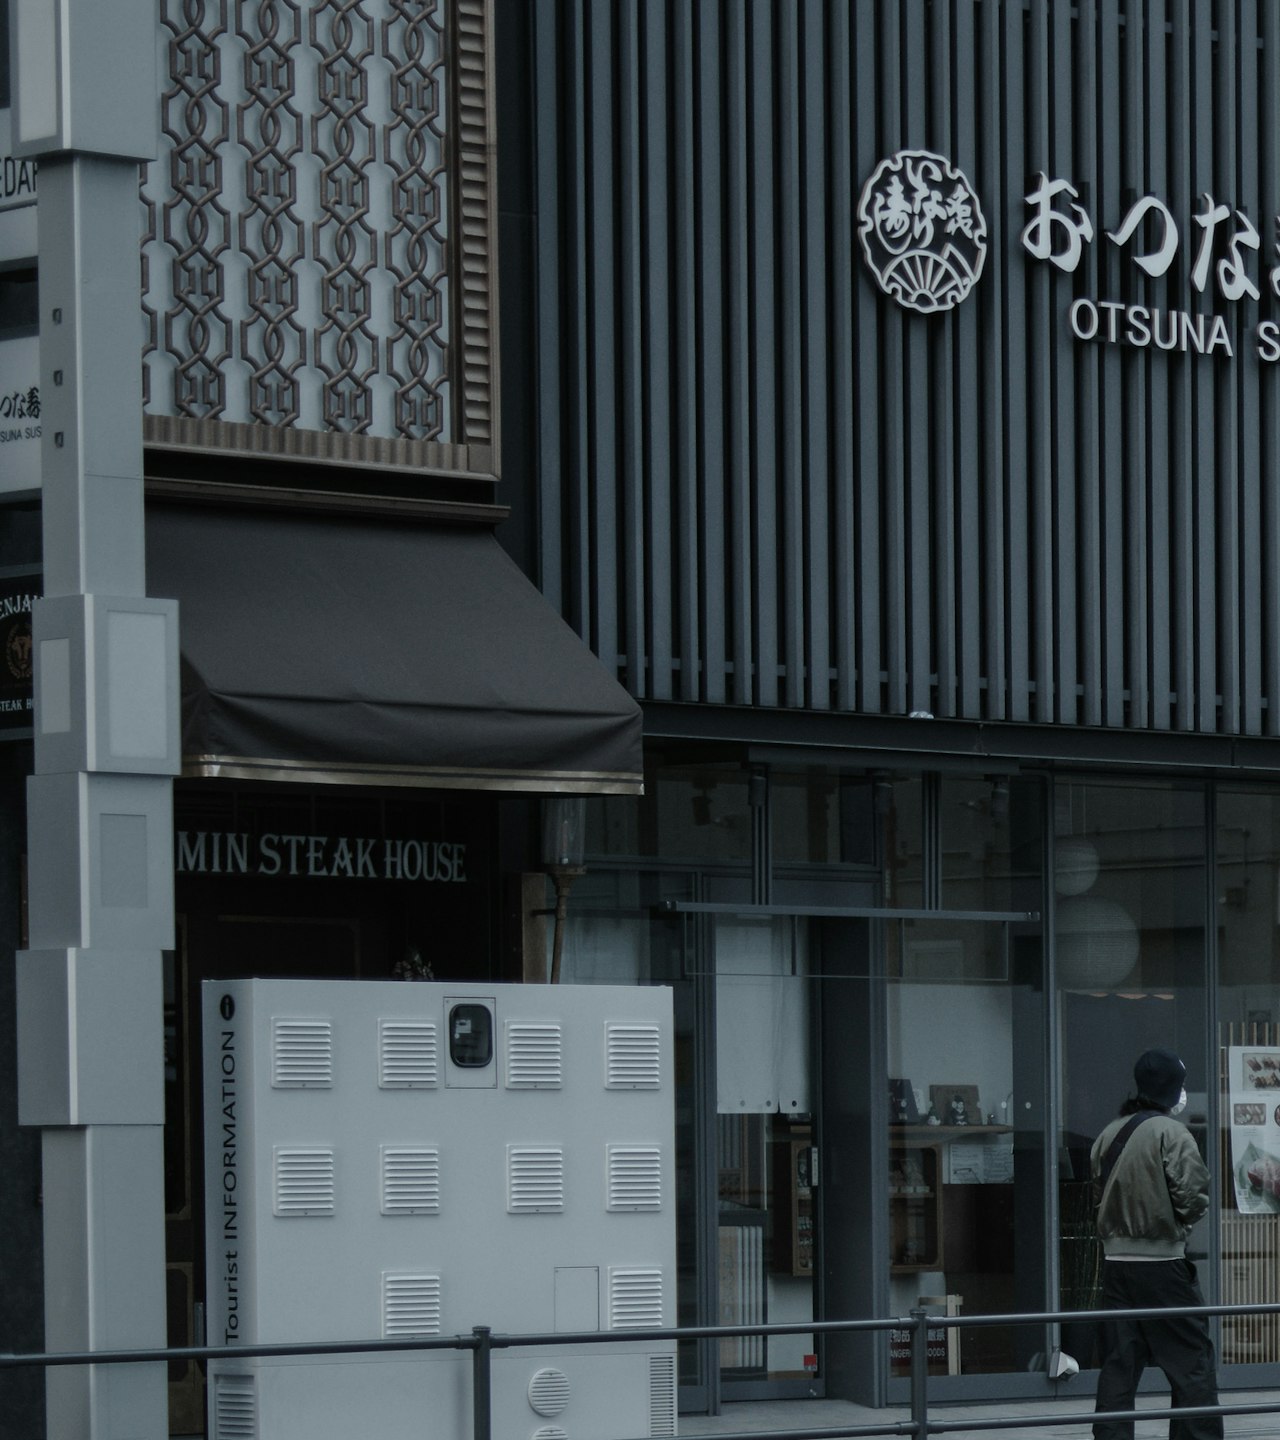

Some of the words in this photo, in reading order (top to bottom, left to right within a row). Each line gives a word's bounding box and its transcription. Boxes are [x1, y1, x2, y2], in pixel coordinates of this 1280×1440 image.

[1069, 298, 1234, 358] OTSUNA
[258, 833, 378, 879] STEAK
[384, 839, 468, 883] HOUSE
[221, 1030, 238, 1240] INFORMATION
[224, 1250, 239, 1345] Tourist
